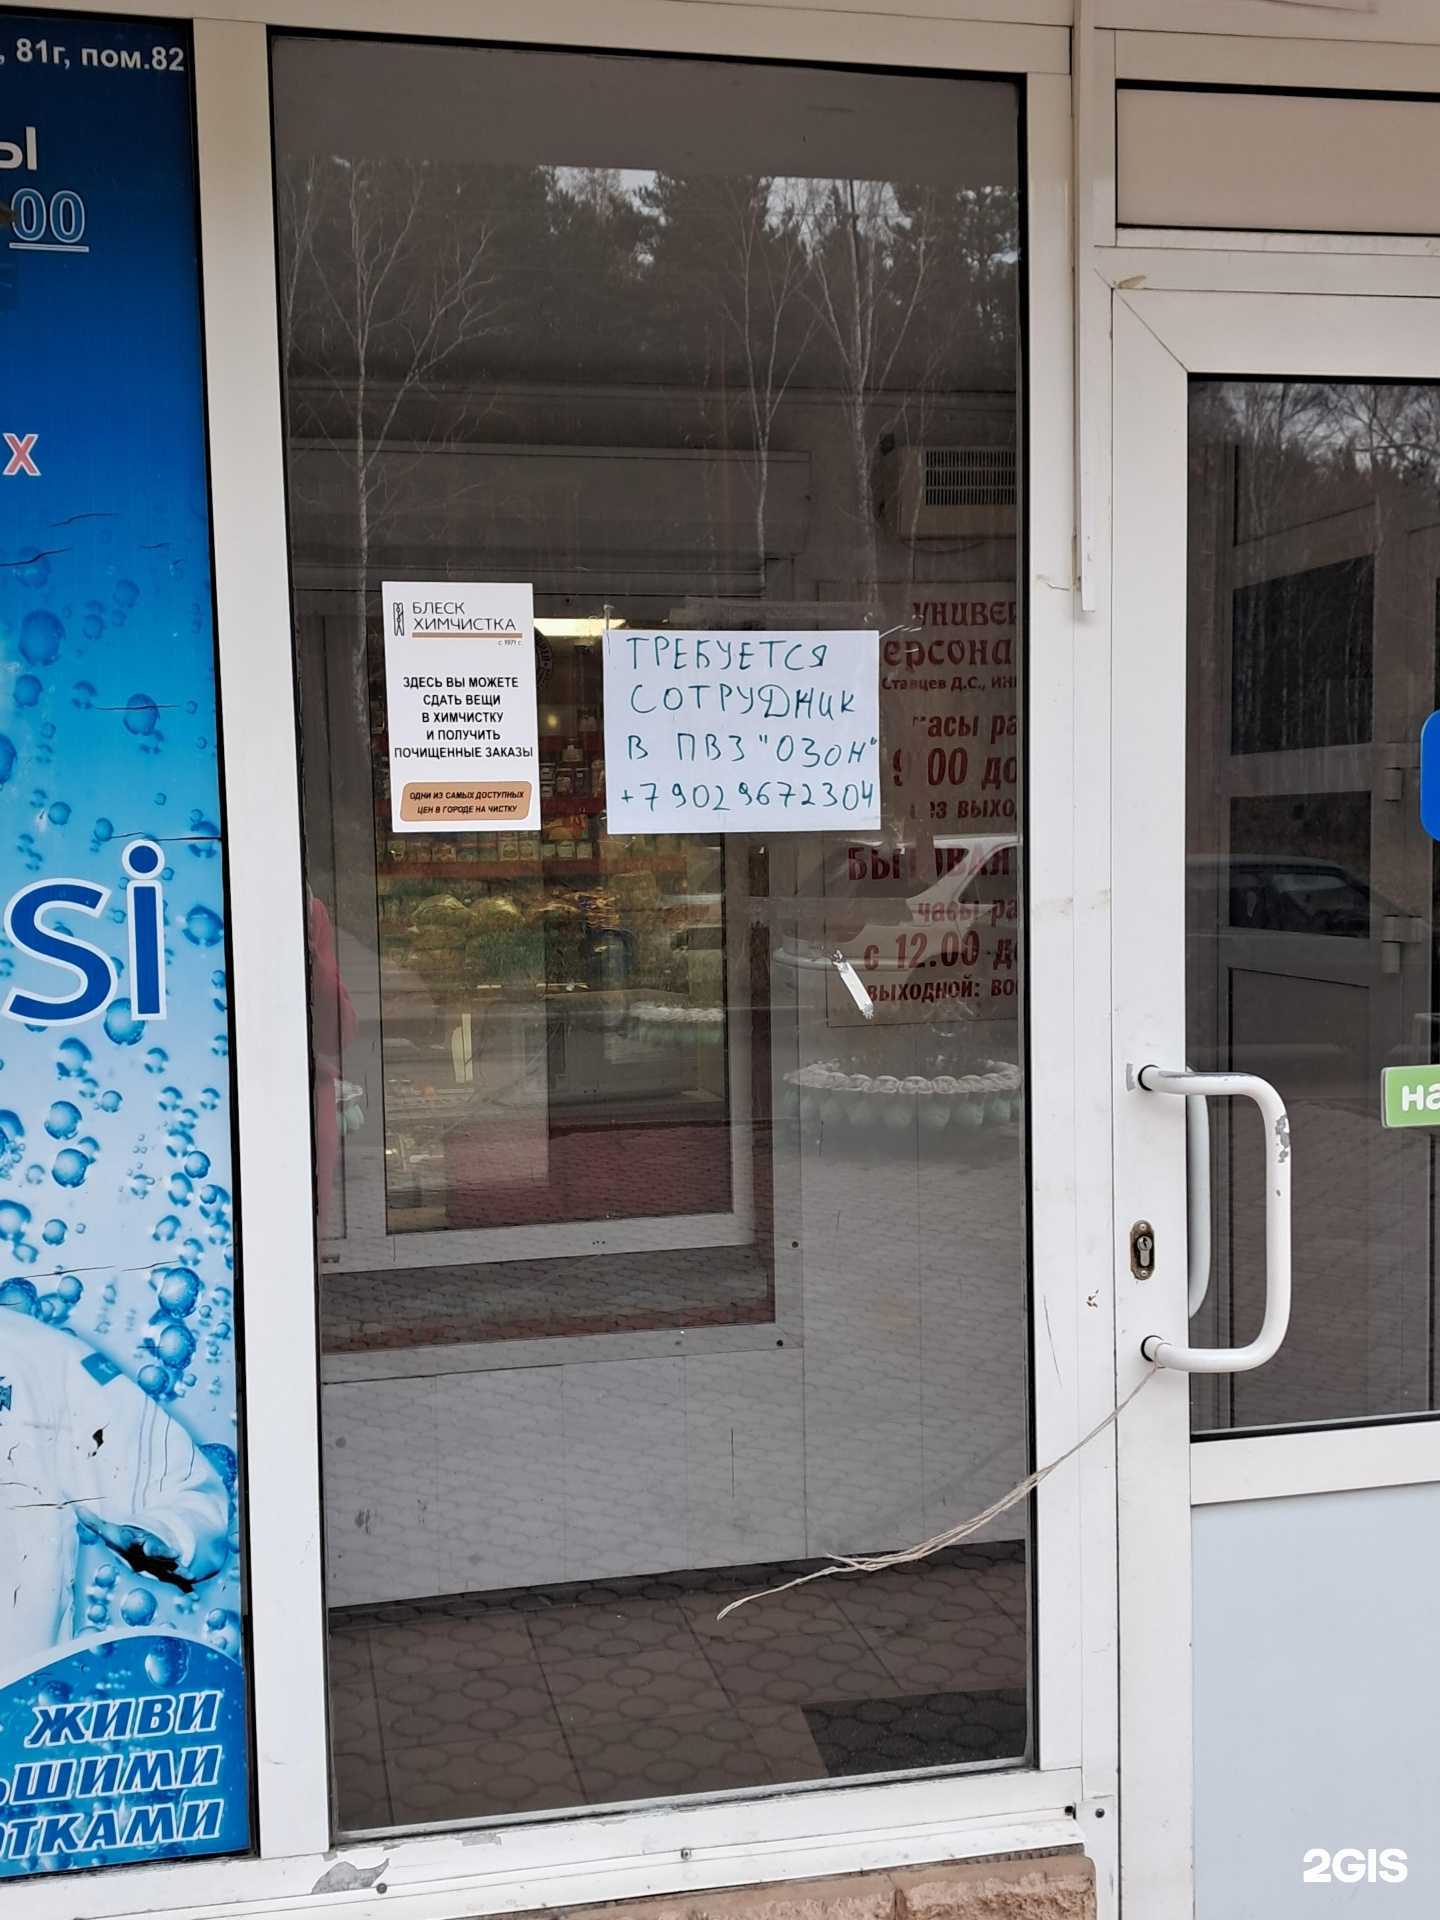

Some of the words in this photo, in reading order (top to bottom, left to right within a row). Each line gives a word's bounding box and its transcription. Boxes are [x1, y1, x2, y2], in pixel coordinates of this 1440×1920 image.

[81, 46, 185, 72] пом.82
[412, 602, 465, 615] БЛЕСК
[414, 618, 517, 631] ХИМЧИСТКА
[626, 636, 828, 671] ТРЕБУЕТСЯ
[403, 677, 443, 688] ЗДЕСЬ
[447, 677, 465, 688] ВЫ
[469, 677, 519, 688] МОЖЕТЕ
[423, 694, 462, 706] СДАТЬ
[466, 694, 501, 707] ВЕЩИ
[630, 683, 856, 721] СОТРУДНИК
[422, 712, 429, 723] В
[433, 712, 504, 723] ХИМЧИСТКУ
[426, 730, 434, 740] И
[438, 730, 501, 740] ПОЛУЧИТЬ
[394, 747, 482, 759] ПОЧИЩЕННЫЕ
[485, 746, 533, 758] ЗАКАЗЫ
[628, 735, 649, 761] В
[677, 733, 745, 761] ПВЗ
[410, 792, 431, 800] ОДНИ
[445, 791, 474, 799] САМЫХ
[475, 791, 525, 800] ДОСТУПНЫХ
[417, 806, 433, 814] ЦЕН
[442, 806, 473, 814] ГОРОДЕ
[488, 805, 518, 813] ЧИСТКУ
[895, 930, 980, 969] 12.00
[24, 1690, 223, 1748] ЖИВИ
[0, 1745, 222, 1807] ШИМИ
[0, 1799, 224, 1860] ТКАМИ
